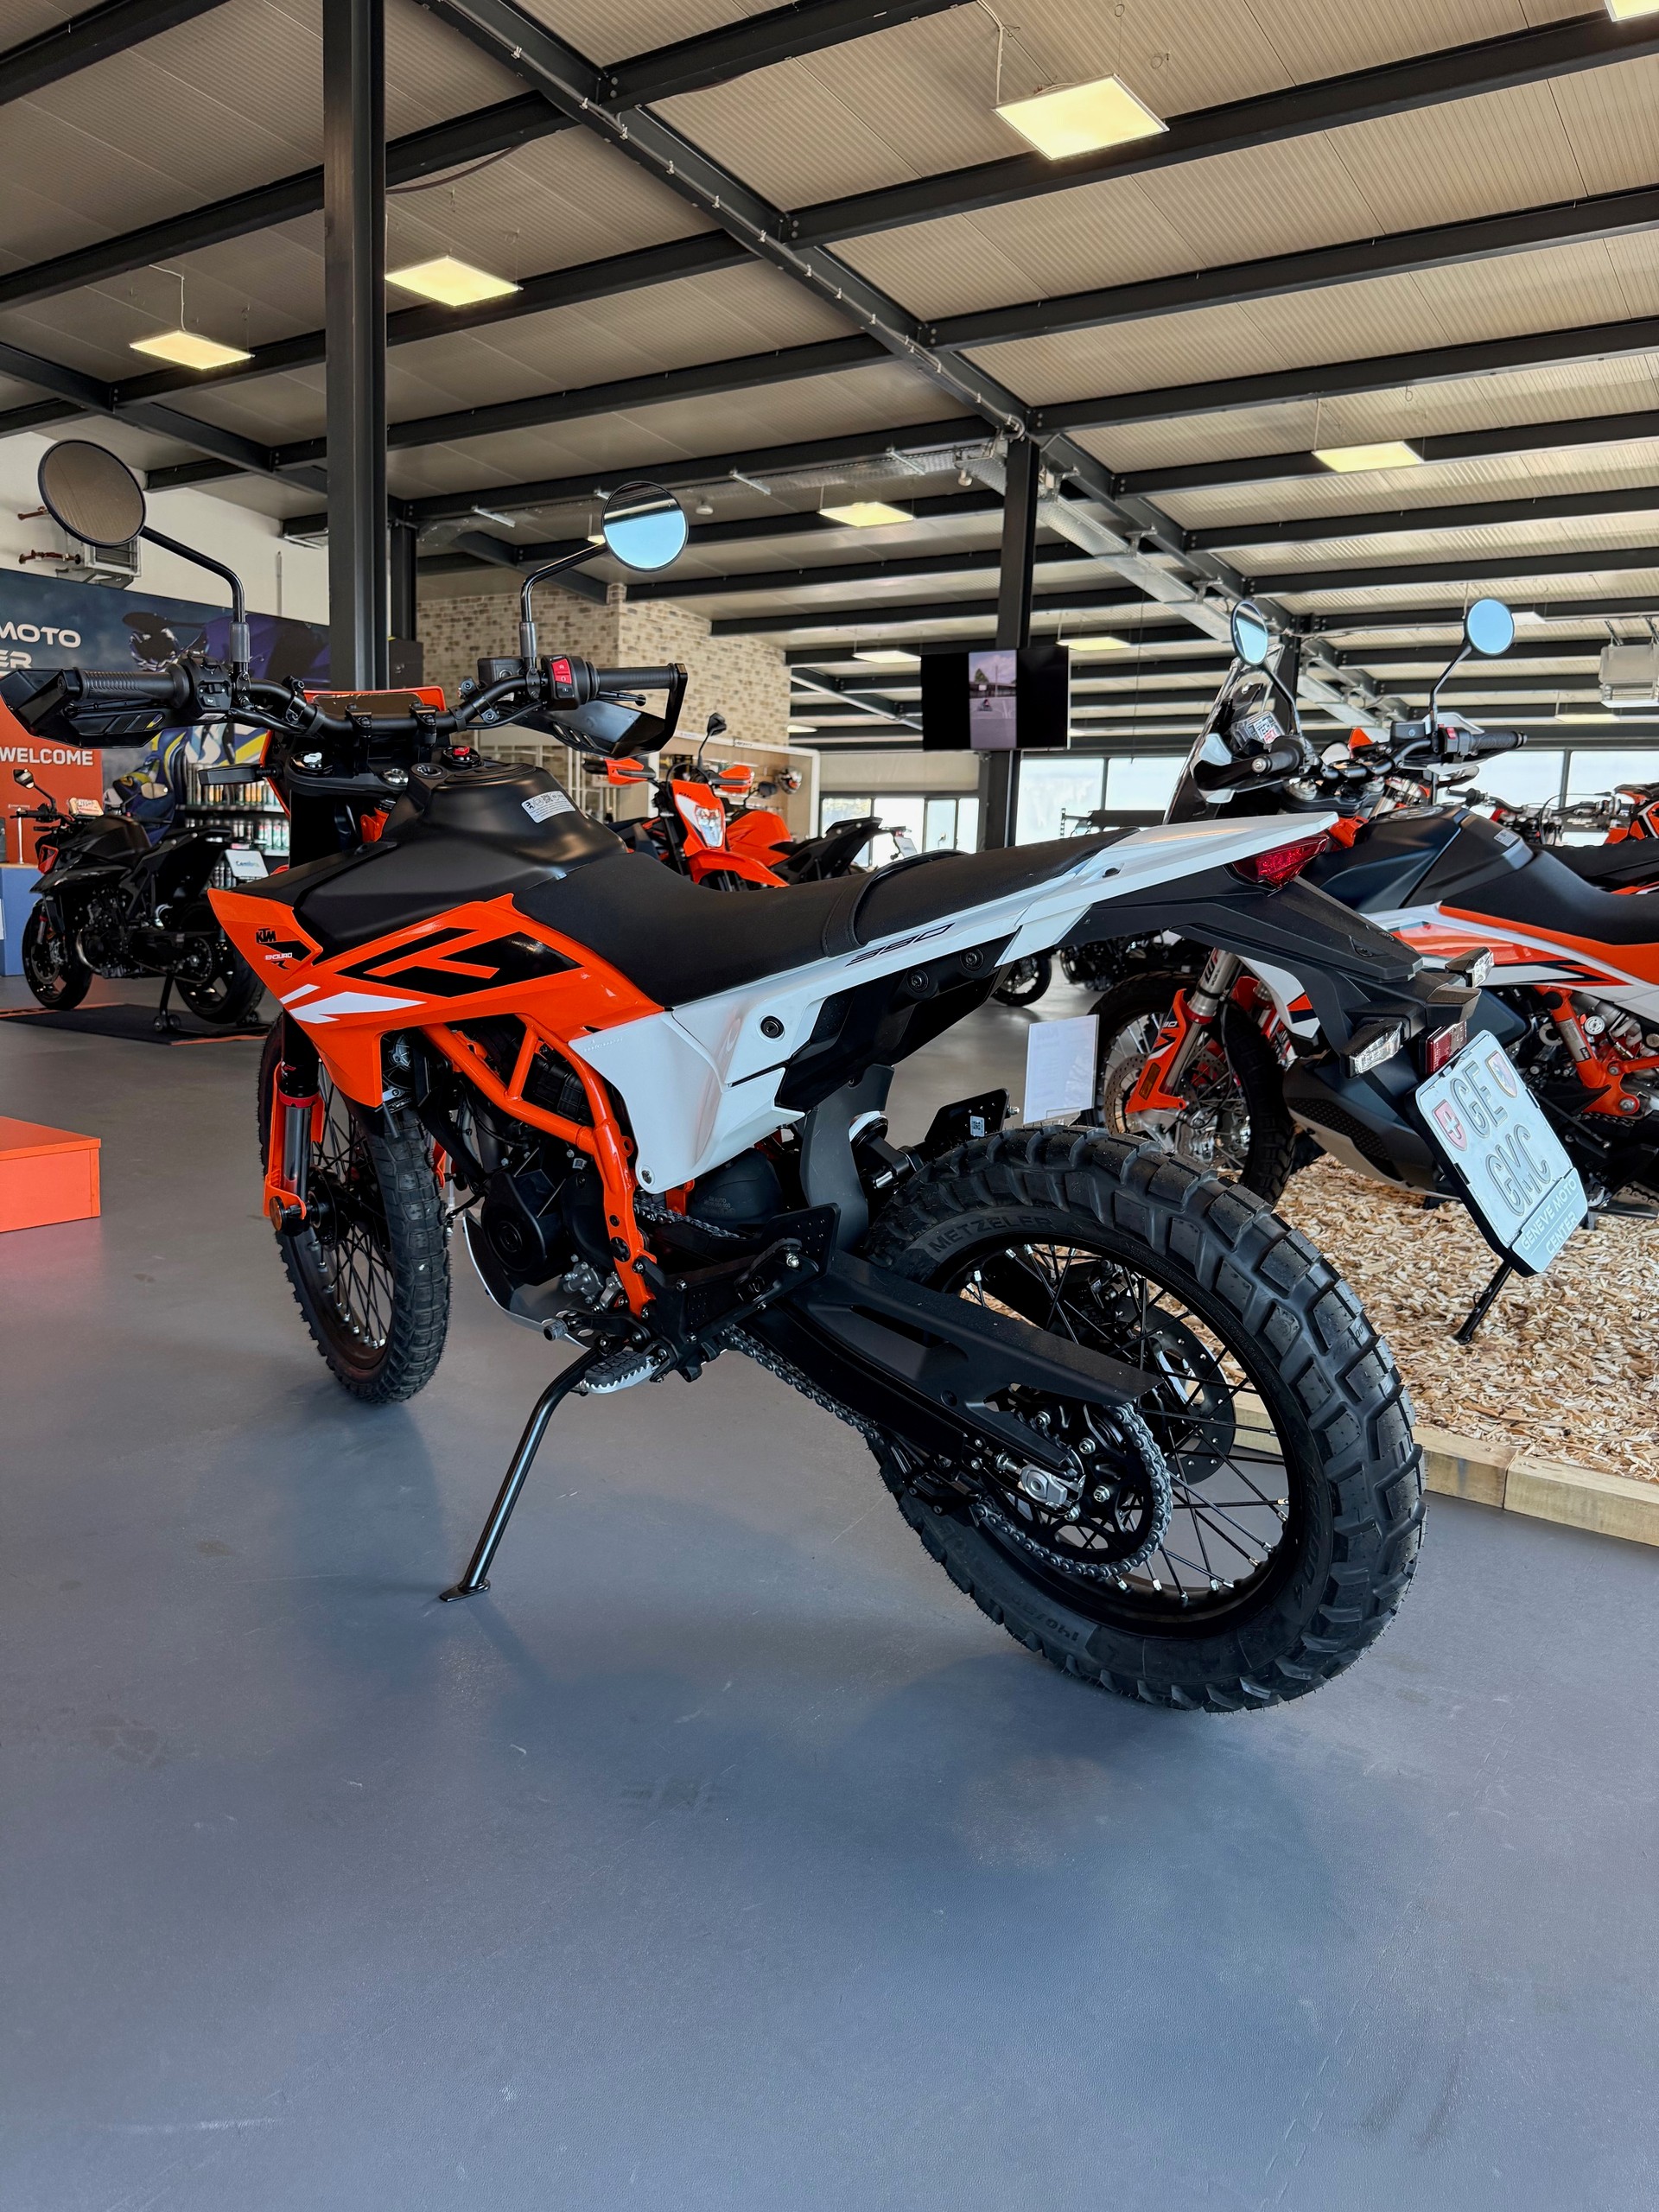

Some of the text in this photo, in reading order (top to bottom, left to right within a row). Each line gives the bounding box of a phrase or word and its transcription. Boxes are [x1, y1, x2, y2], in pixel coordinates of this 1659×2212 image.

[0, 747, 93, 766] WELCOME
[256, 928, 276, 944] KTM
[264, 952, 293, 961] ENDURO
[1450, 1060, 1508, 1139] GE
[1521, 1177, 1578, 1251] GENEVE MOTO
[1545, 1211, 1579, 1255] CENTER
[927, 1215, 1058, 1253] METZELER
